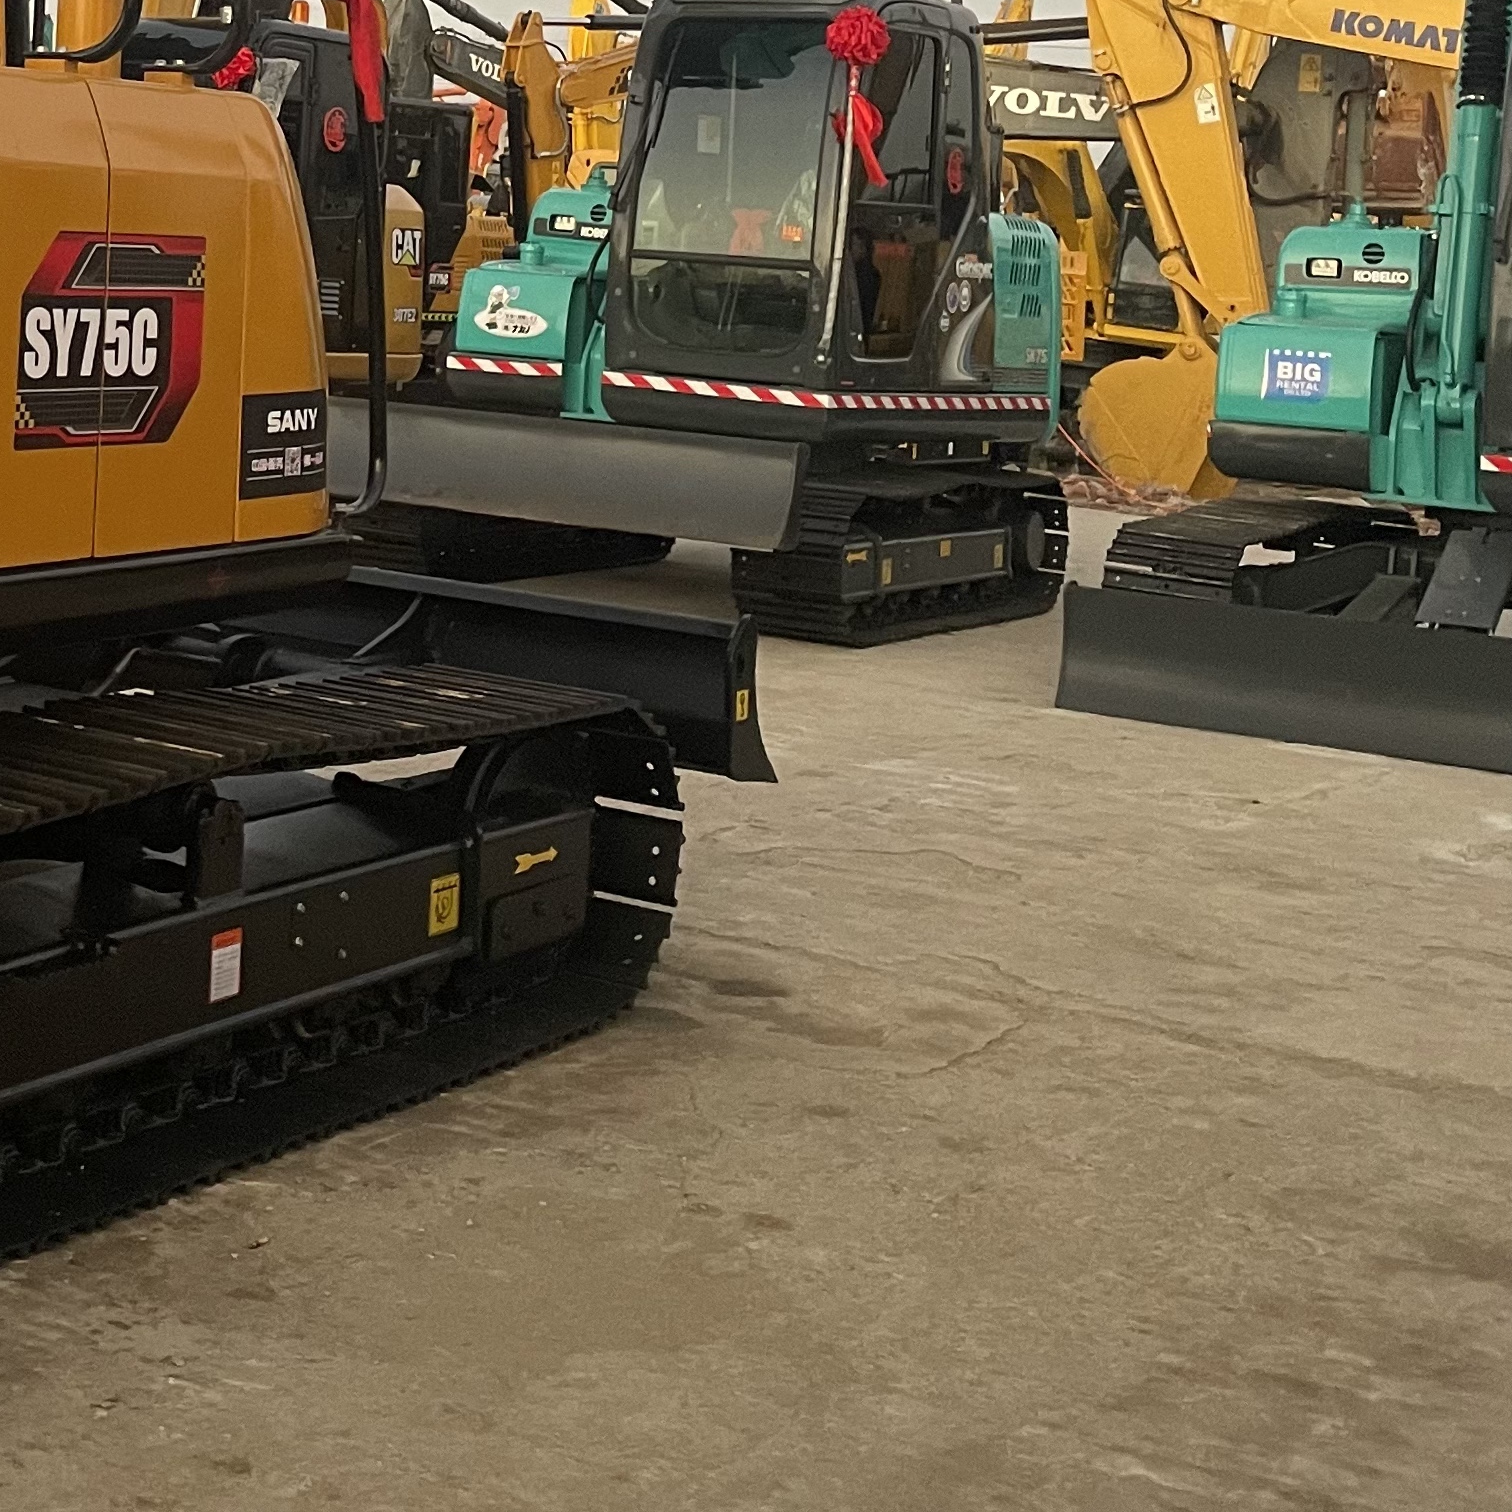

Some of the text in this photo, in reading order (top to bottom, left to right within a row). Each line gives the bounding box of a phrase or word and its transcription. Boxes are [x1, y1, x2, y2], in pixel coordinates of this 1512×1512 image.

[1330, 7, 1460, 54] KOMAT
[392, 228, 422, 266] CAT
[1353, 269, 1409, 284] KOBELCO
[24, 306, 159, 379] SY75C
[1276, 361, 1322, 382] BIG
[1276, 379, 1320, 392] RENTAL
[267, 408, 318, 434] SANY
